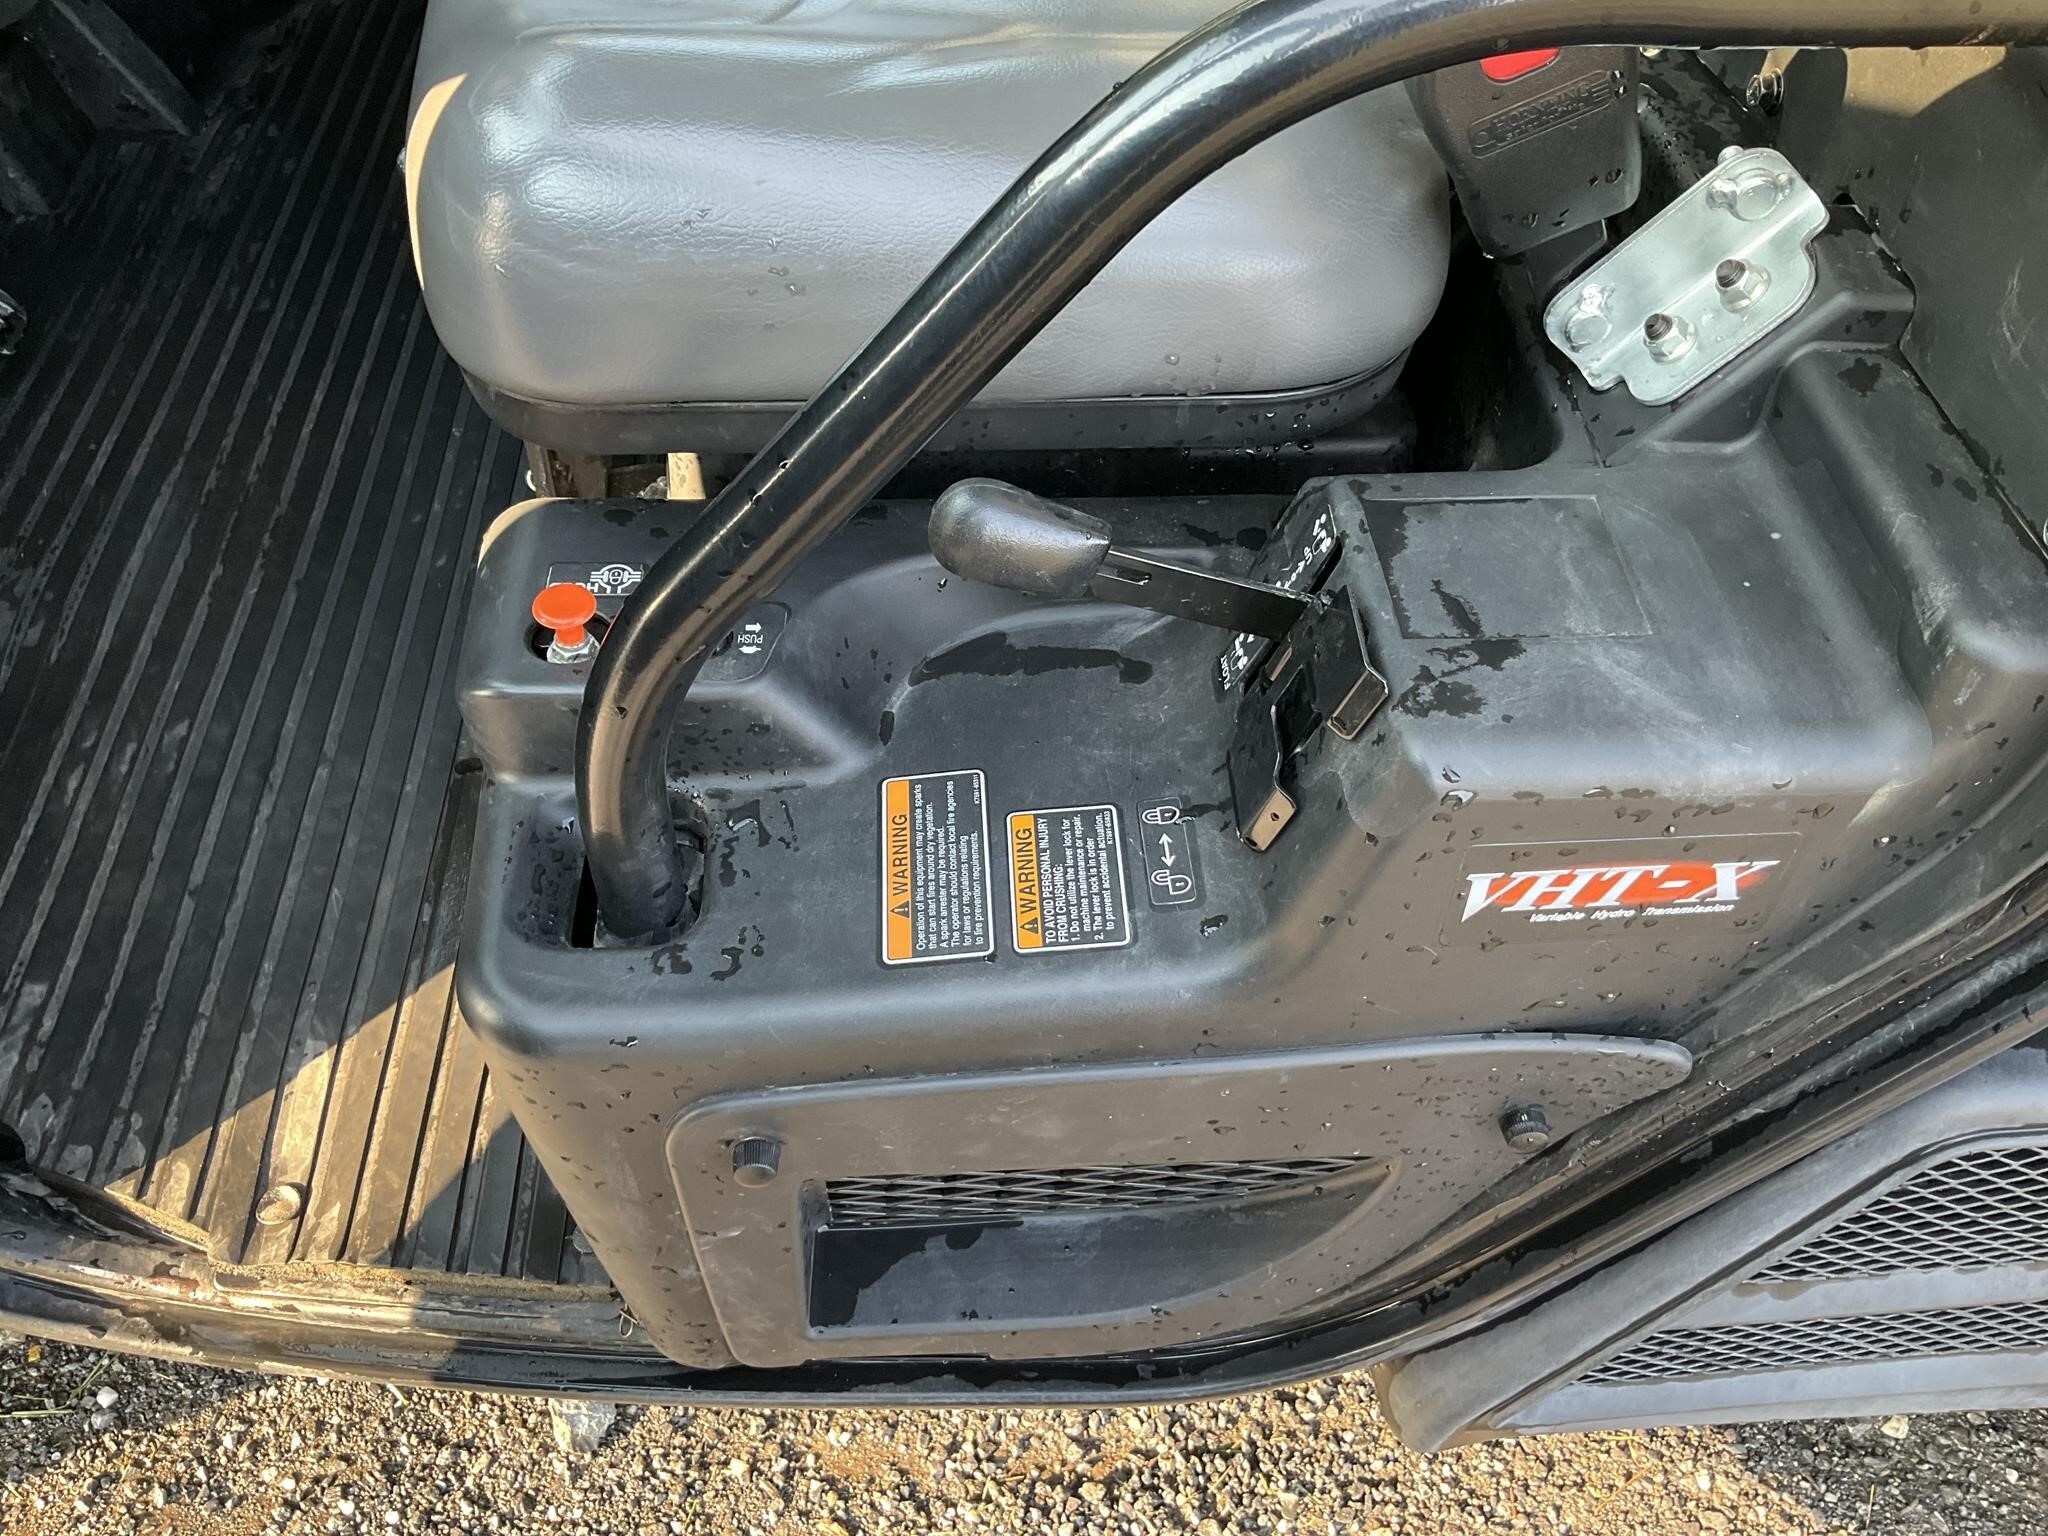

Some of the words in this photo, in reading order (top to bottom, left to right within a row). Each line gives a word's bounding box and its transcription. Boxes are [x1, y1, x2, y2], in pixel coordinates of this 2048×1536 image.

[737, 634, 763, 644] PUSH
[1220, 654, 1232, 691] FLOAT
[914, 785, 923, 807] sparks
[946, 781, 955, 811] agencies
[915, 808, 923, 830] create
[925, 802, 935, 840] vegetation.
[946, 813, 954, 824] fire
[1062, 819, 1070, 829] for
[1073, 814, 1084, 837] repair.
[916, 831, 924, 846] may
[947, 826, 955, 842] local
[1038, 818, 1048, 848] INJURY
[1062, 831, 1071, 846] lock
[1095, 813, 1106, 849] actuation.
[926, 842, 935, 853] dry
[936, 826, 946, 857] required.
[959, 836, 969, 862] relating
[1076, 839, 1083, 847] or
[1086, 838, 1095, 857] order
[892, 814, 908, 896] WARNING
[938, 859, 946, 868] be
[948, 844, 957, 870] contact
[970, 831, 981, 880] requirements.
[1065, 848, 1074, 866] lever
[916, 848, 925, 885] equipment
[926, 855, 934, 880] around
[1016, 828, 1037, 914] WARNING
[1040, 850, 1053, 897] PERSONAL
[1067, 868, 1075, 880] the
[1076, 849, 1088, 896] maintenance
[1098, 850, 1111, 888] accidental
[940, 870, 948, 886] may
[949, 871, 958, 896] should
[961, 864, 971, 904] regulations
[1090, 877, 1099, 893] lock
[916, 887, 924, 901] this
[926, 882, 935, 897] fires
[1053, 864, 1066, 913] CRUSHING:
[1068, 882, 1077, 904] utilize
[1461, 860, 1781, 922] VHT-X
[916, 902, 924, 910] of
[927, 899, 935, 916] start
[963, 906, 970, 914] or
[973, 882, 983, 921] prevention
[1090, 895, 1101, 914] lever
[1102, 890, 1116, 920] prevent
[952, 898, 960, 929] operator
[1044, 900, 1055, 927] AVOID
[1070, 906, 1078, 919] not
[1080, 898, 1091, 931] machine
[1529, 911, 1586, 922] Variable
[1590, 907, 1635, 920] Hydro
[1643, 904, 1735, 916] Transmission
[915, 911, 926, 950] Operation
[940, 919, 949, 940] spark
[962, 916, 971, 933] laws
[974, 923, 982, 935] fire
[1058, 916, 1068, 942] FROM
[1070, 920, 1079, 932] Do
[1093, 916, 1102, 930] The
[928, 934, 936, 949] that
[951, 931, 960, 947] The
[963, 935, 971, 945] for
[1045, 931, 1056, 943] TO
[1072, 934, 1080, 942] 1.
[1095, 932, 1104, 940] 2.
